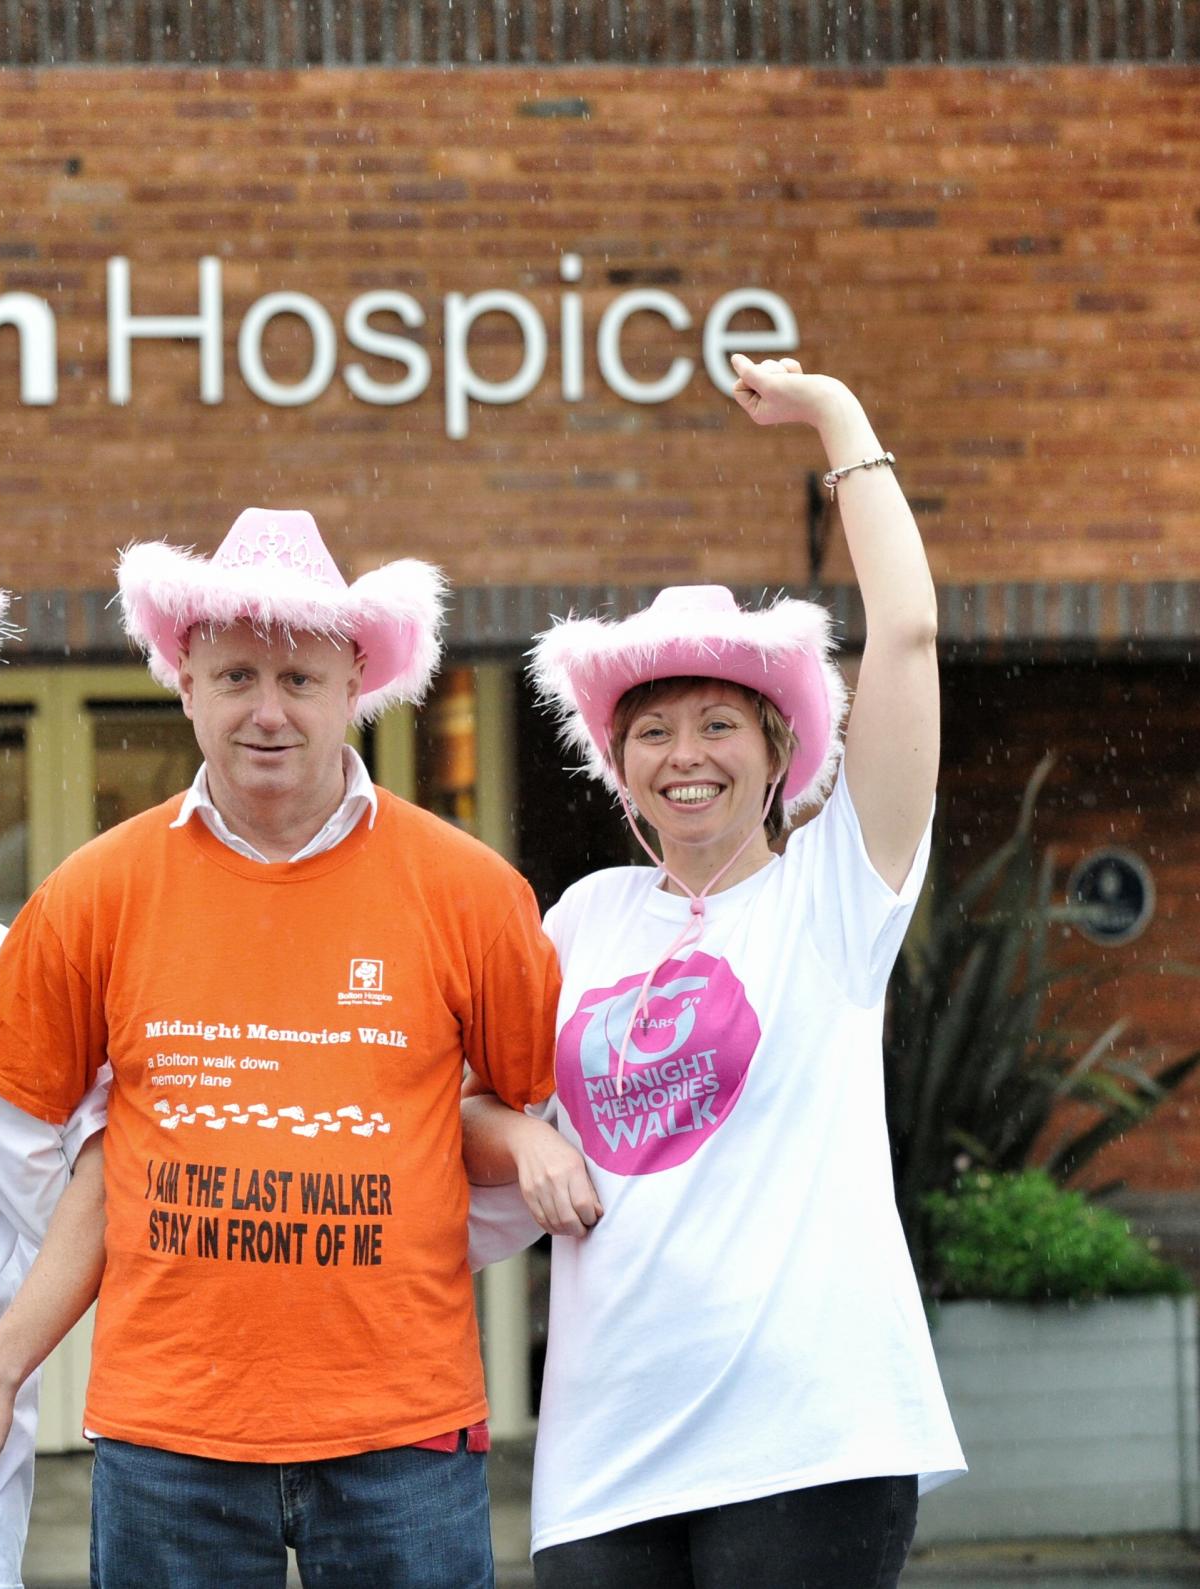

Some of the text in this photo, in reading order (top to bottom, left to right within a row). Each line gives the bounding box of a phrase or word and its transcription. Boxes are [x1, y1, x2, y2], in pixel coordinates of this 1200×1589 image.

[105, 252, 801, 440] Hospice
[145, 1020, 408, 1048] Midnight Memories Walk
[147, 1053, 280, 1071] a Bolton walk down
[151, 1072, 232, 1089] memory lane
[583, 1049, 717, 1102] MIDNIGHT
[590, 1073, 721, 1124] MEMORIES
[597, 1095, 718, 1153] WALK
[144, 1159, 393, 1216] I AM THE LAST WALKER
[149, 1209, 383, 1267] STAY IN FRONT OF ME
